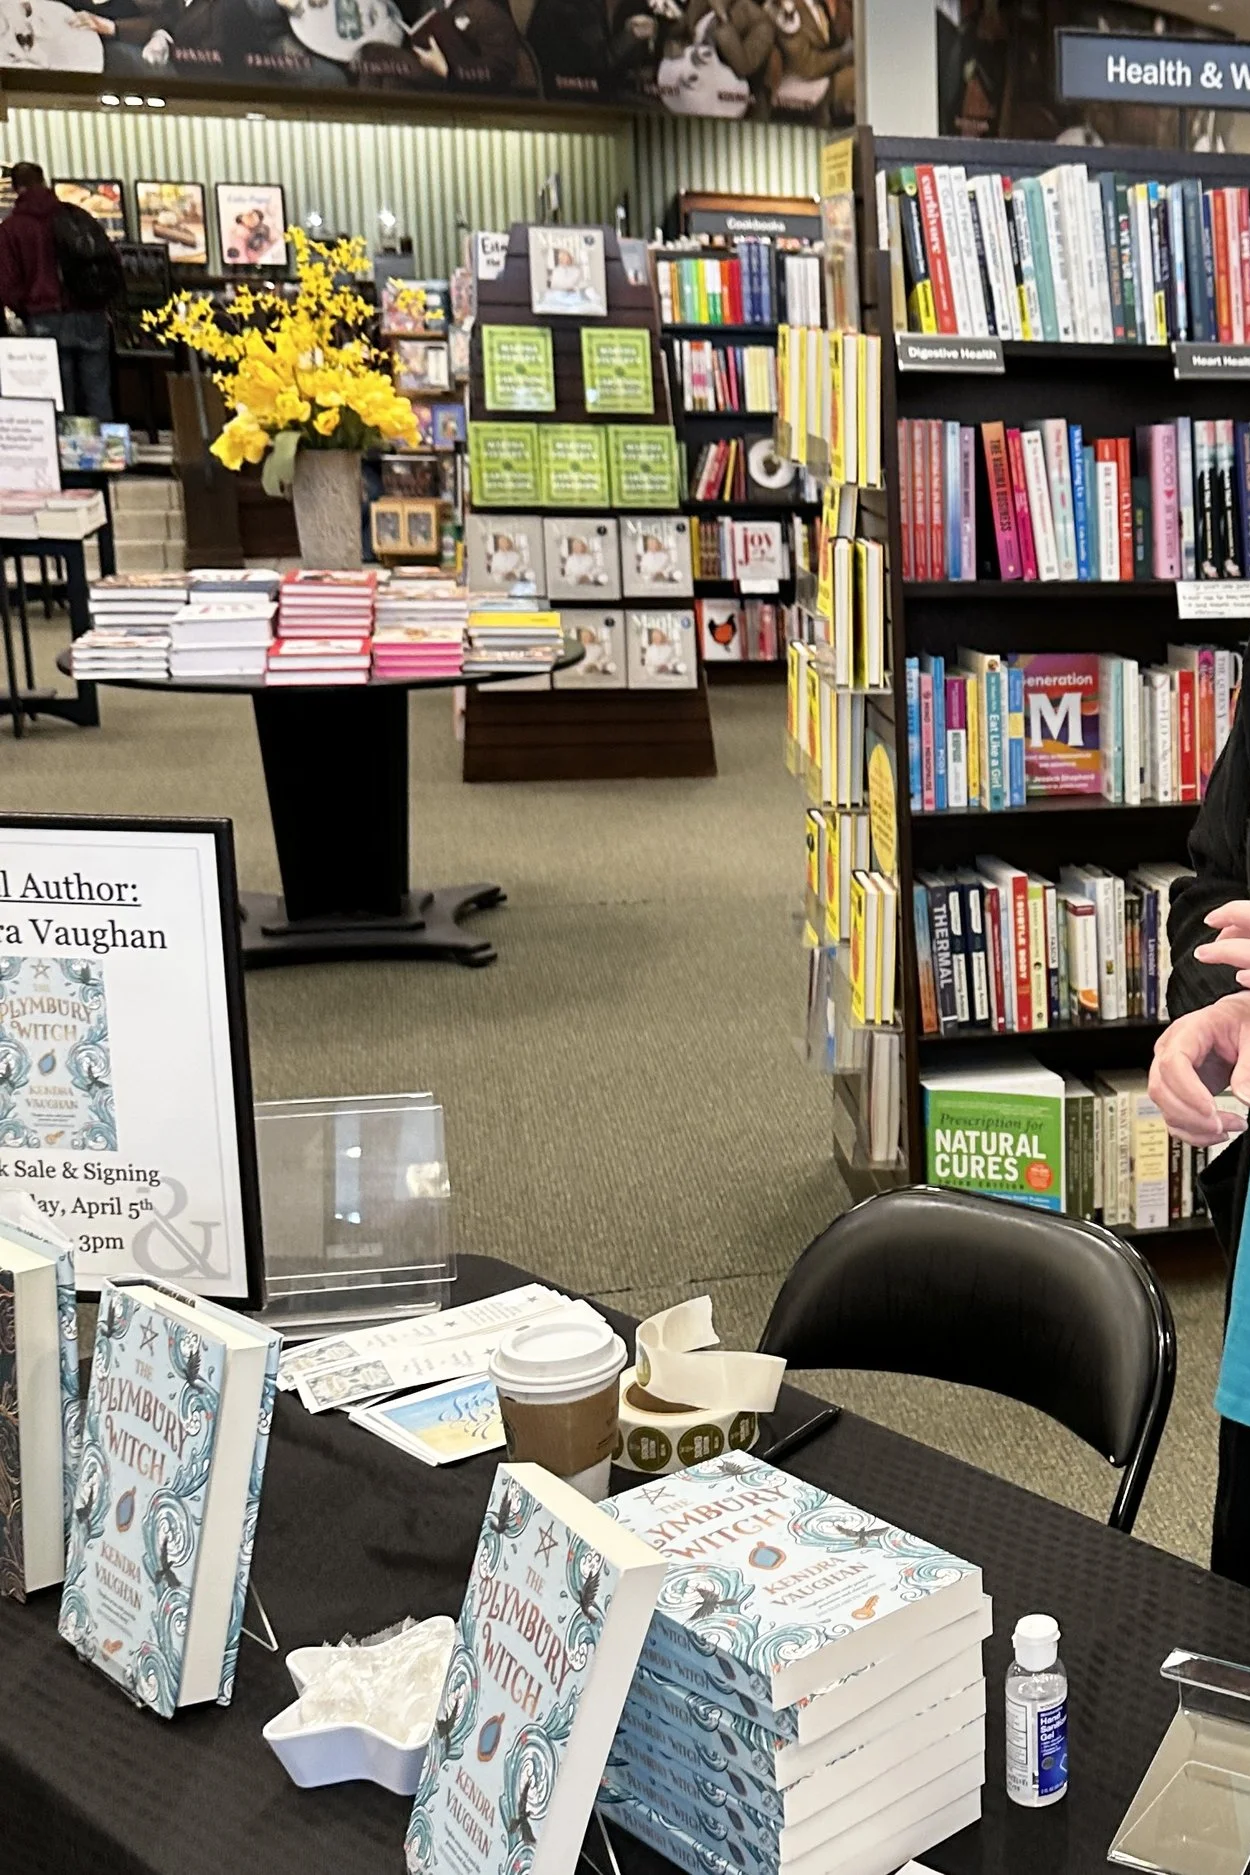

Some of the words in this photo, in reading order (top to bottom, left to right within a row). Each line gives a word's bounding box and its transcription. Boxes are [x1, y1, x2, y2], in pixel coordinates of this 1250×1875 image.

[1106, 55, 1192, 89] Health
[1201, 61, 1222, 90] &
[726, 217, 786, 233] Cookbooks
[921, 175, 942, 255] carbivore
[908, 345, 959, 360] Digestive
[960, 346, 997, 361] Health
[1192, 355, 1222, 367] Heart
[990, 439, 1001, 454] THE
[996, 491, 1011, 533] BUSINESS
[1122, 492, 1131, 542] CYCLE
[1023, 671, 1094, 687] eneration
[1218, 656, 1226, 674] THE
[990, 714, 999, 732] Eat
[1027, 691, 1085, 748] M
[990, 735, 1000, 758] Like
[991, 769, 1002, 789] Girl
[20, 872, 138, 903] Author:
[28, 918, 168, 955] Vaughan
[1017, 901, 1026, 946] SUBTLE
[932, 904, 953, 989] THERMAL
[1148, 939, 1156, 977] Lavender
[1018, 949, 1027, 979] BODY
[0, 996, 93, 1025] PLYMBURY
[10, 1020, 78, 1041] WITCH
[940, 1113, 1022, 1130] Prescription
[1025, 1120, 1044, 1133] for
[935, 1128, 1047, 1159] NATURAL
[14, 1159, 57, 1178] Sale
[62, 1161, 79, 1180] &
[84, 1161, 161, 1187] Signing
[935, 1153, 1019, 1182] CURES
[71, 1196, 122, 1219] April
[128, 1198, 154, 1220] 5th
[78, 1234, 125, 1254] 3pm
[135, 1359, 155, 1382] THE
[98, 1377, 190, 1461] PLYMBURY
[104, 1414, 167, 1485] WITCH
[646, 1485, 793, 1550] LYMBURY
[655, 1497, 694, 1516] THE
[660, 1508, 788, 1560] WITCH
[100, 1540, 141, 1584] KENDRA
[762, 1556, 847, 1595] KENDRA
[95, 1560, 142, 1612] VAUGHAN
[525, 1566, 546, 1598] THE
[770, 1561, 869, 1607] VAUGHAN
[474, 1575, 575, 1697] PLYMBURY
[481, 1624, 544, 1719] WITCH
[673, 1658, 709, 1691] WITCH
[1040, 1711, 1061, 1726] Hand
[1040, 1730, 1055, 1742] Gel
[456, 1765, 496, 1829] KENDRA
[446, 1787, 493, 1859] VAUGHAN
